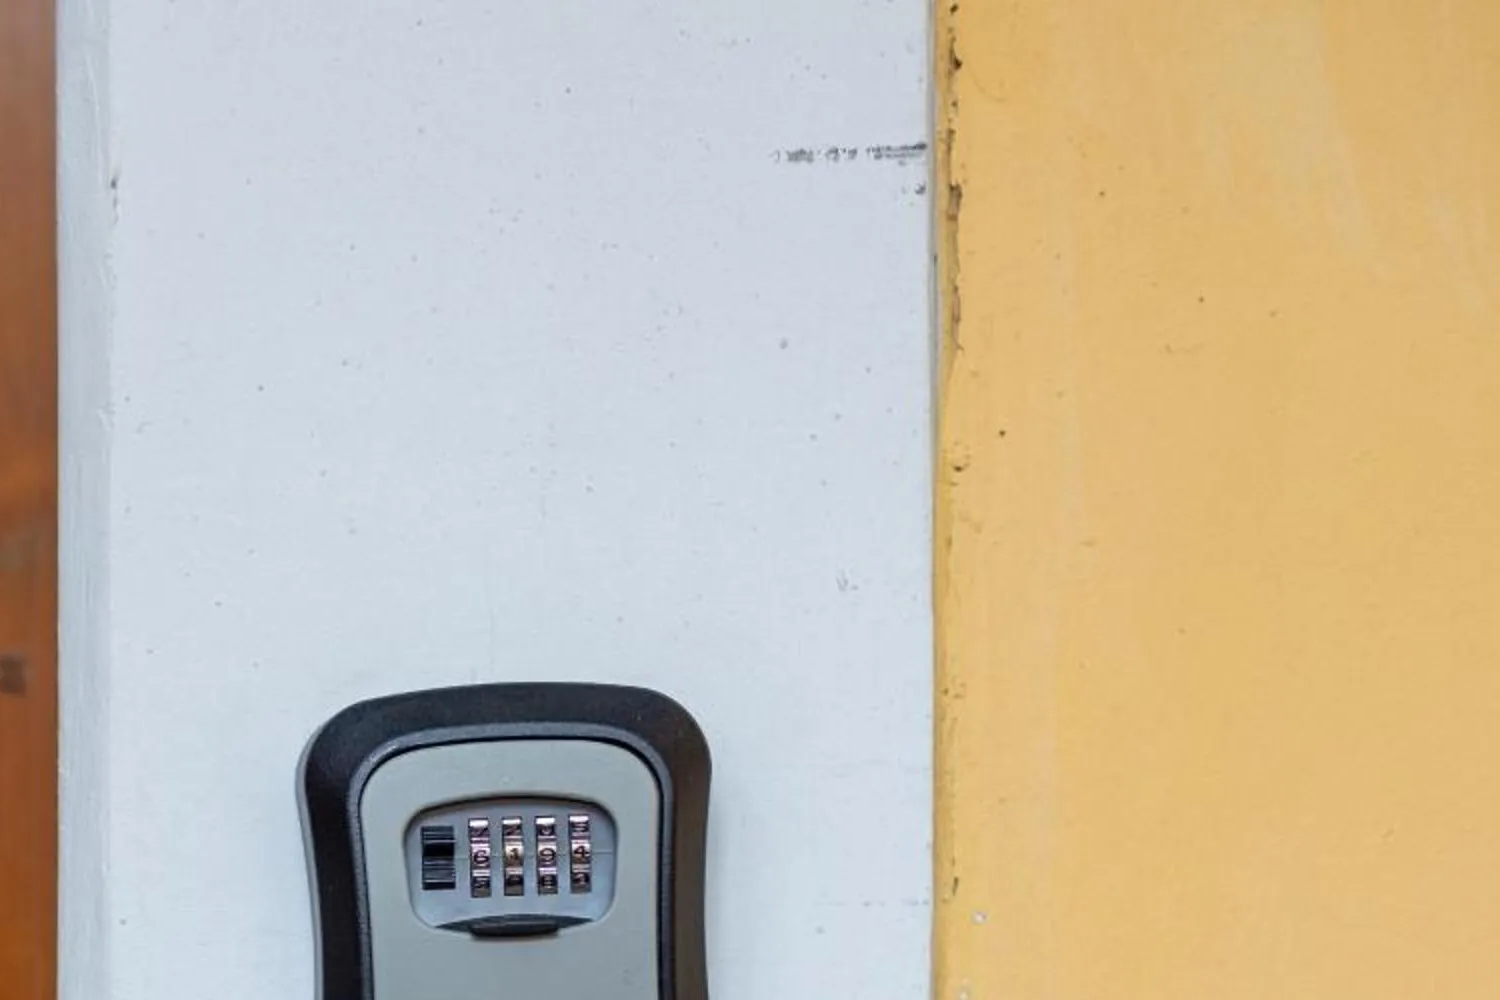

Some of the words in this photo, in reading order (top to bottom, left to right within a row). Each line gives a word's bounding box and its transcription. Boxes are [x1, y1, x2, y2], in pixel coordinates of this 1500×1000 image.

[473, 849, 490, 867] 6
[539, 847, 557, 865] 9
[573, 844, 591, 861] 4
